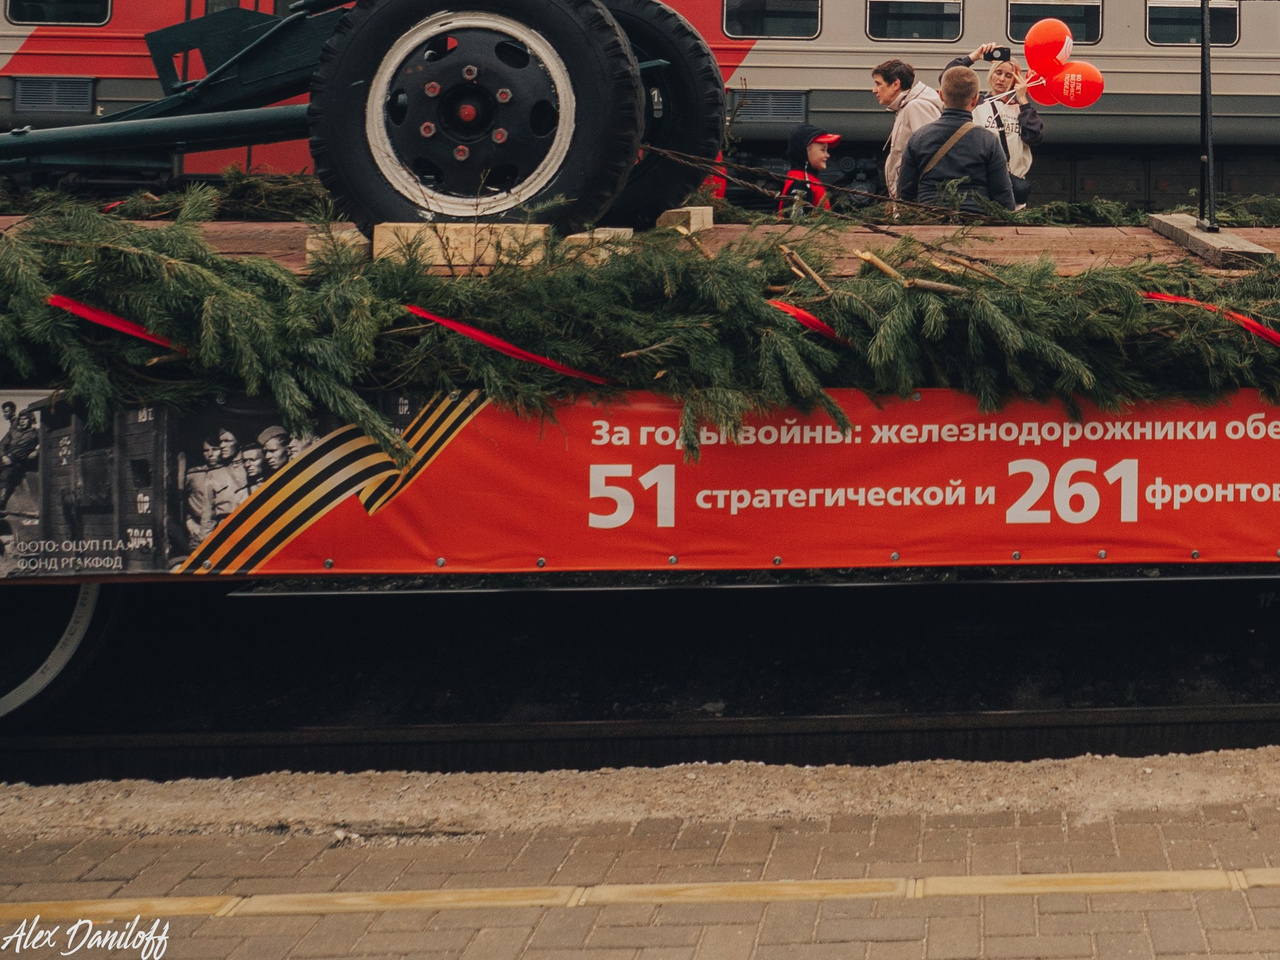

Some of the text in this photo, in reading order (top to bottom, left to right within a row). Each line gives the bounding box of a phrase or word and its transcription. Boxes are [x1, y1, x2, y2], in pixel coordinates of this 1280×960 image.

[591, 420, 630, 445] За
[738, 419, 862, 445] войны:
[871, 420, 1216, 447] железнодорожники
[588, 464, 675, 529] 51
[695, 479, 966, 515] стратегической
[976, 486, 996, 505] и
[1005, 458, 1139, 524] 261
[17, 539, 129, 553] ФОТО: ОЦУП П.А.
[17, 556, 123, 571] ФОНД РГАКФФД
